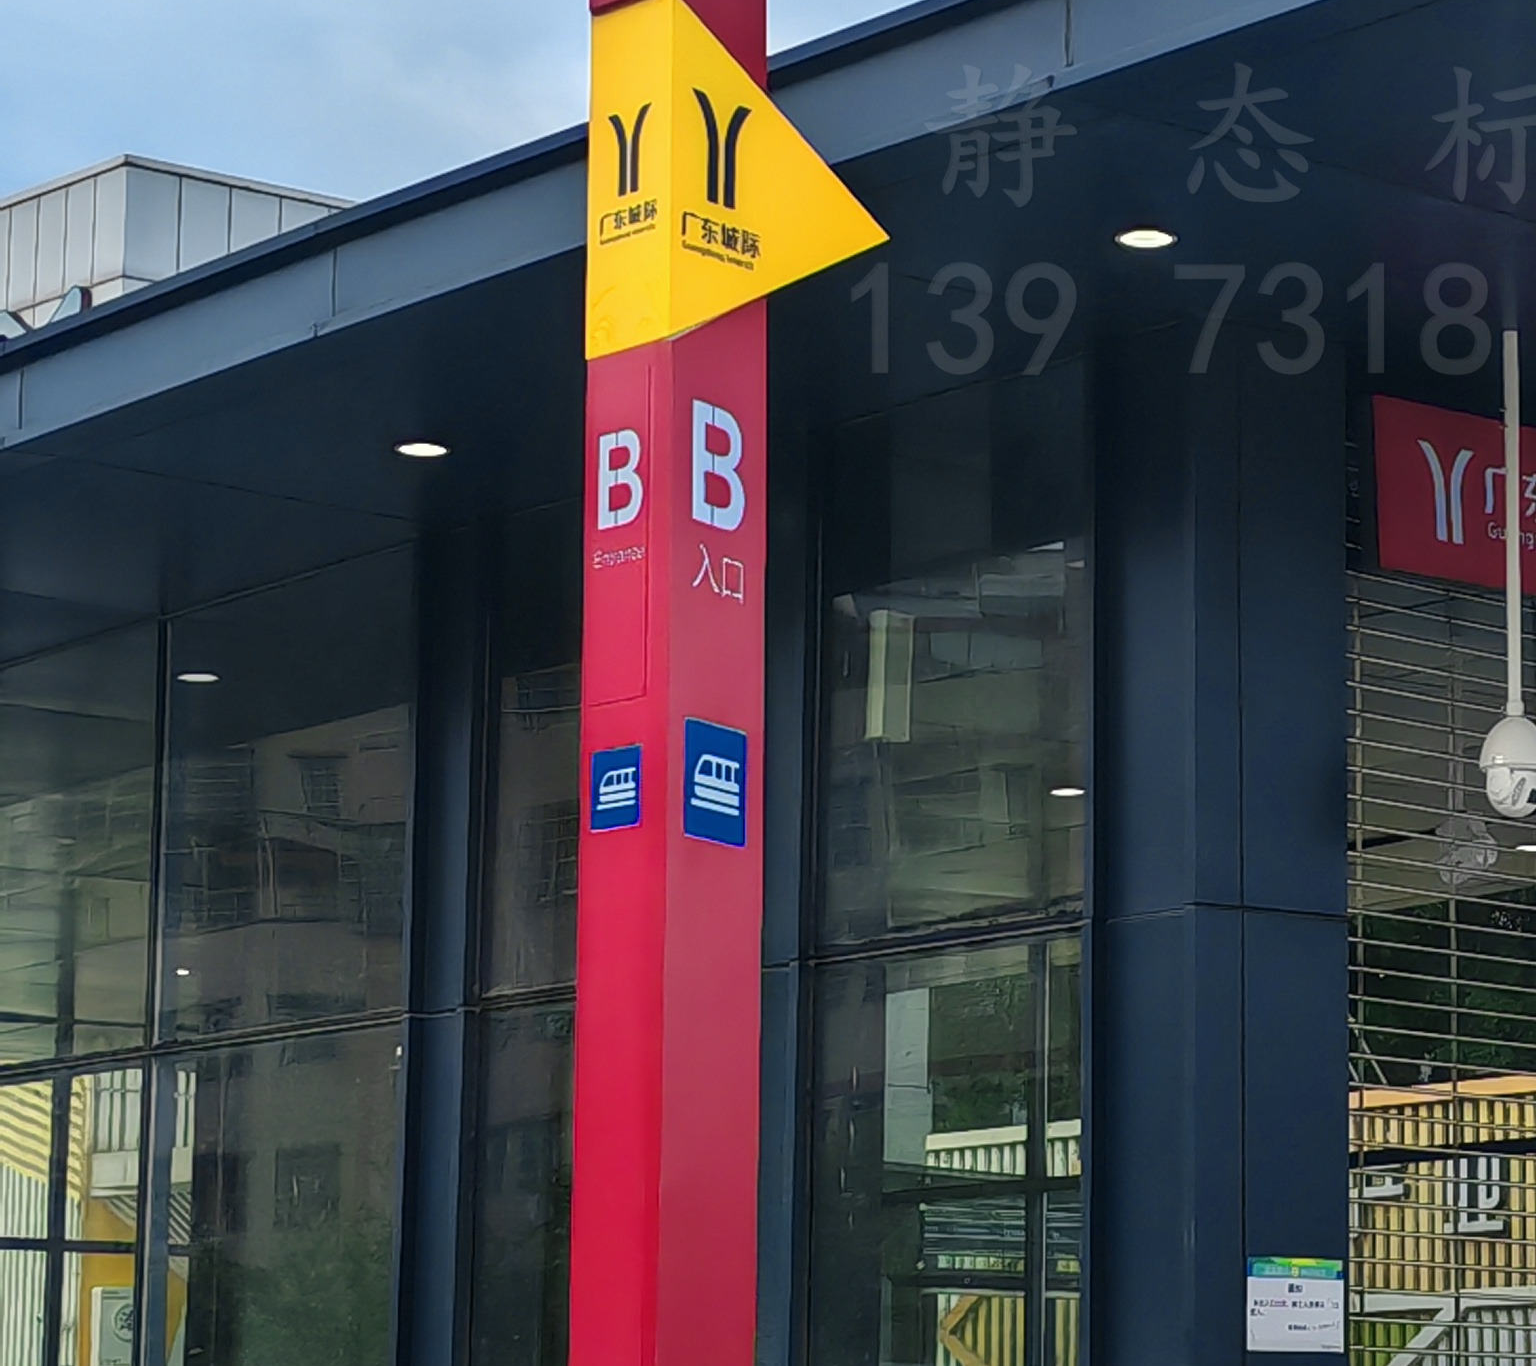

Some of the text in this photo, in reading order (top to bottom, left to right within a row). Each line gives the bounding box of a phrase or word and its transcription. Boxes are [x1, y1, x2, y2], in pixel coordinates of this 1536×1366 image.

[597, 429, 643, 530] B
[691, 398, 746, 532] B
[692, 543, 744, 604] 入口
